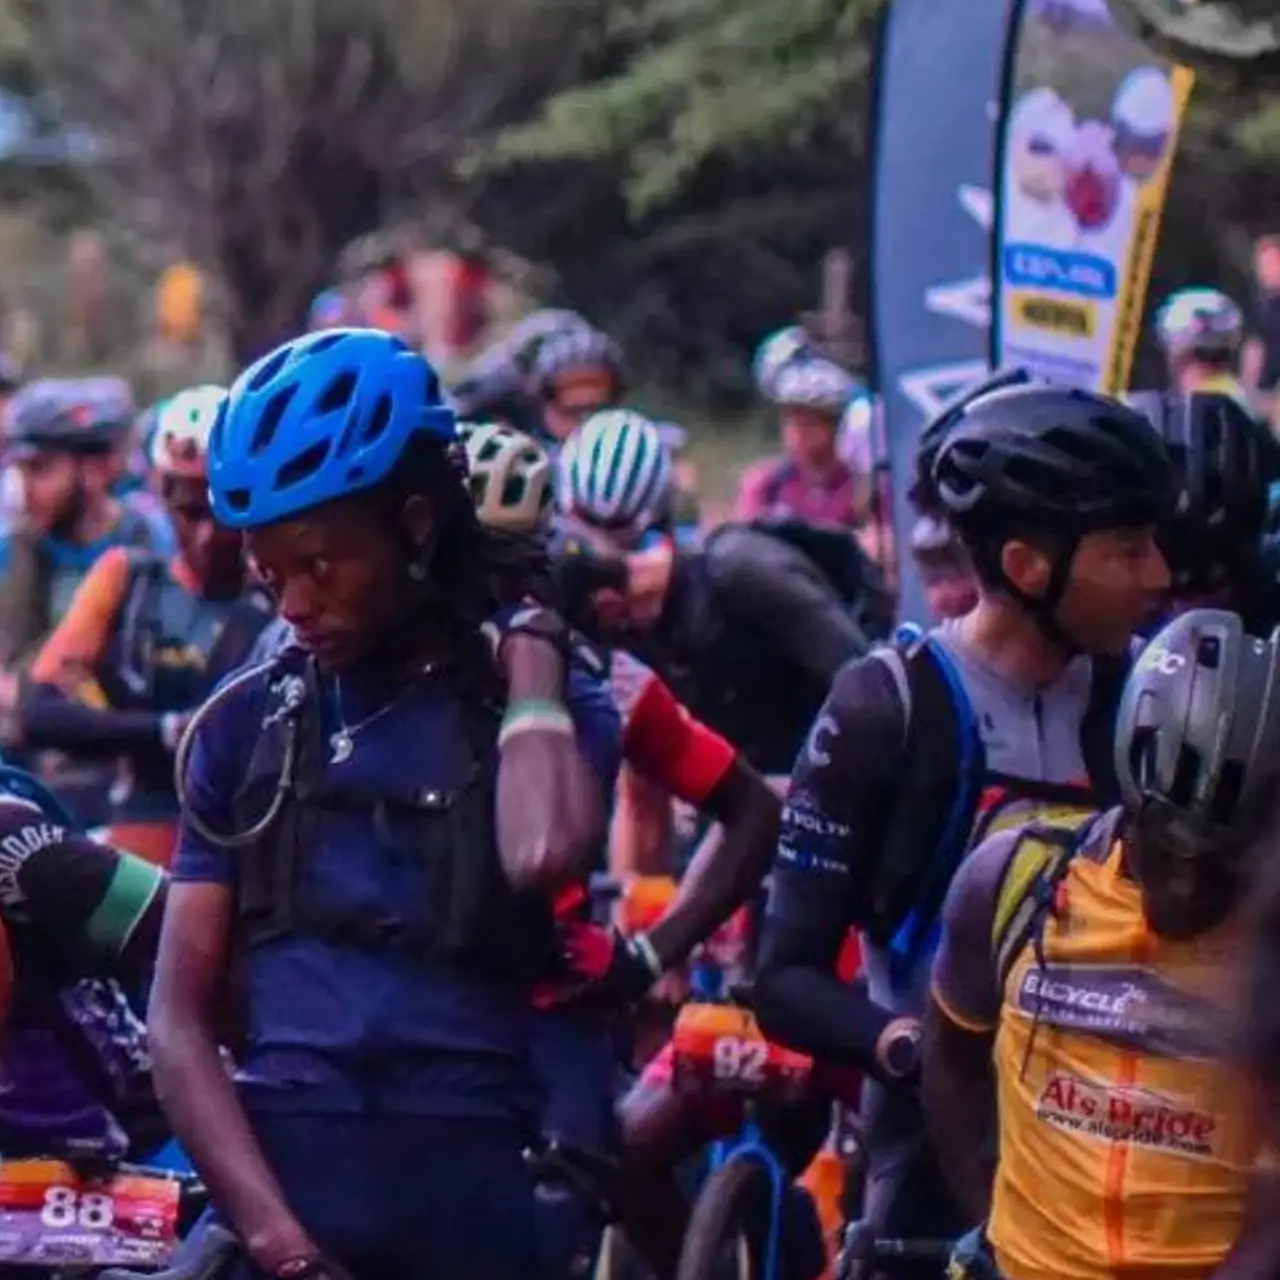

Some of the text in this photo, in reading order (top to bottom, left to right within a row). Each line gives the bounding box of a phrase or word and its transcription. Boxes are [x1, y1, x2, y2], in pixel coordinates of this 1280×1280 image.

[1023, 974, 1127, 1014] BICYCLE
[1108, 1097, 1217, 1142] Pride
[41, 1186, 114, 1229] 88
